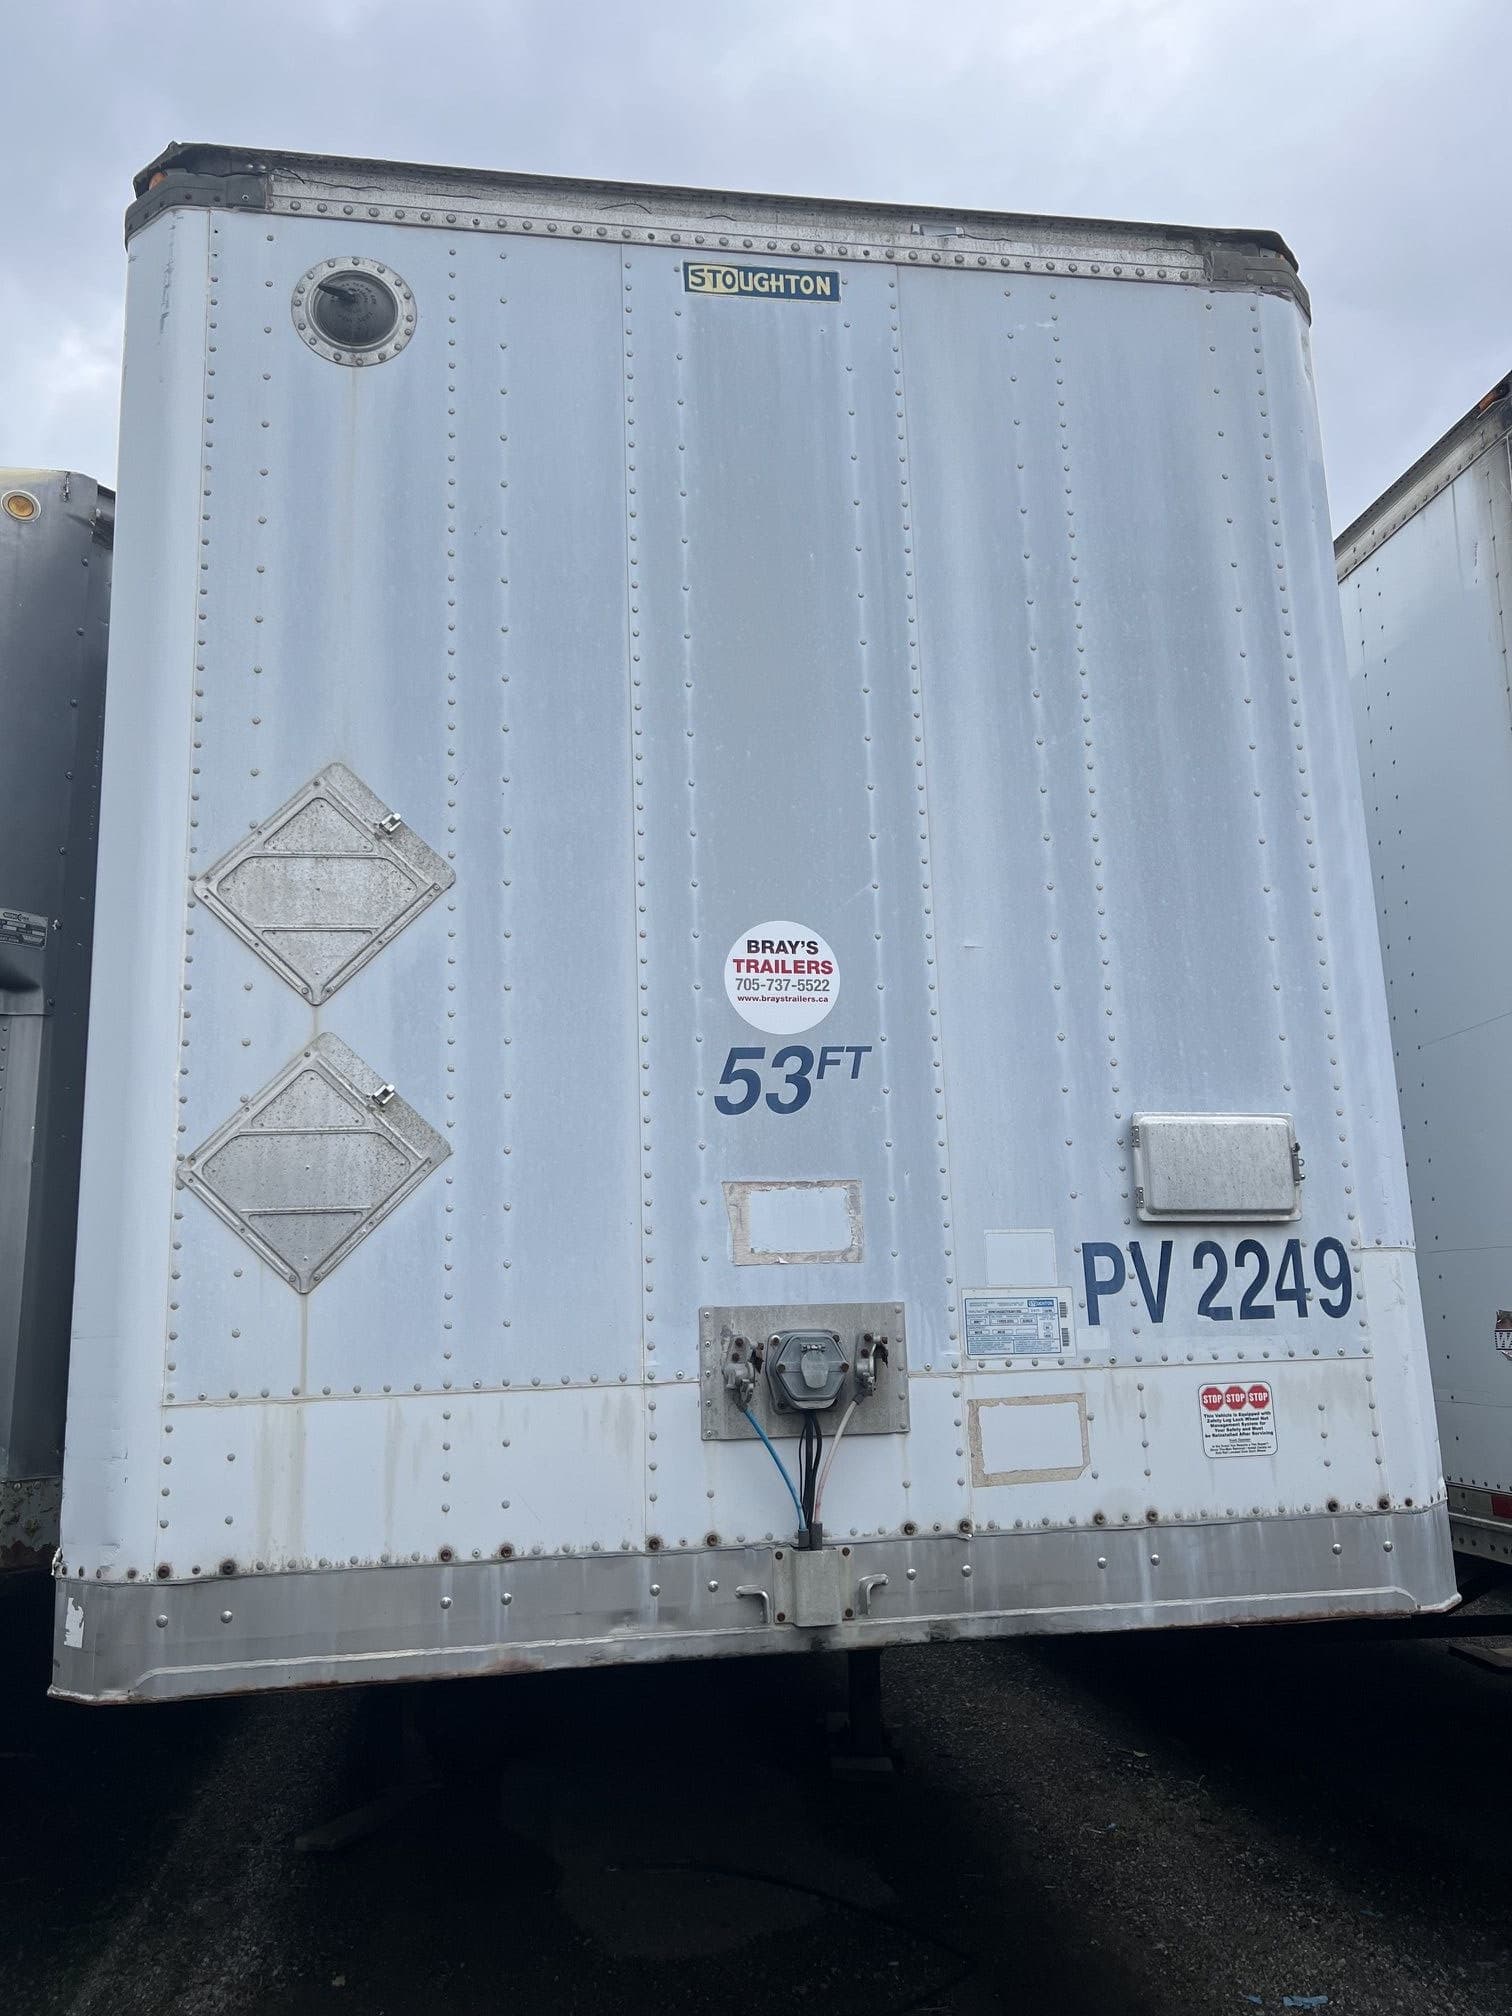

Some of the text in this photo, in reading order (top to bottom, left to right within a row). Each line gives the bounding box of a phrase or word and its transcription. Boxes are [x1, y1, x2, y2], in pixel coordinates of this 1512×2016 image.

[690, 269, 831, 296] STOUGHTON
[747, 940, 819, 954] BRAY'S
[733, 959, 833, 974] TRAILERS
[735, 978, 830, 991] 705-737-5522
[737, 995, 828, 1003] www.braystrailers.ca
[714, 1045, 872, 1115] 53 FT
[1082, 1236, 1352, 1325] PV 2249
[1203, 1392, 1268, 1404] STOP STOP STOP
